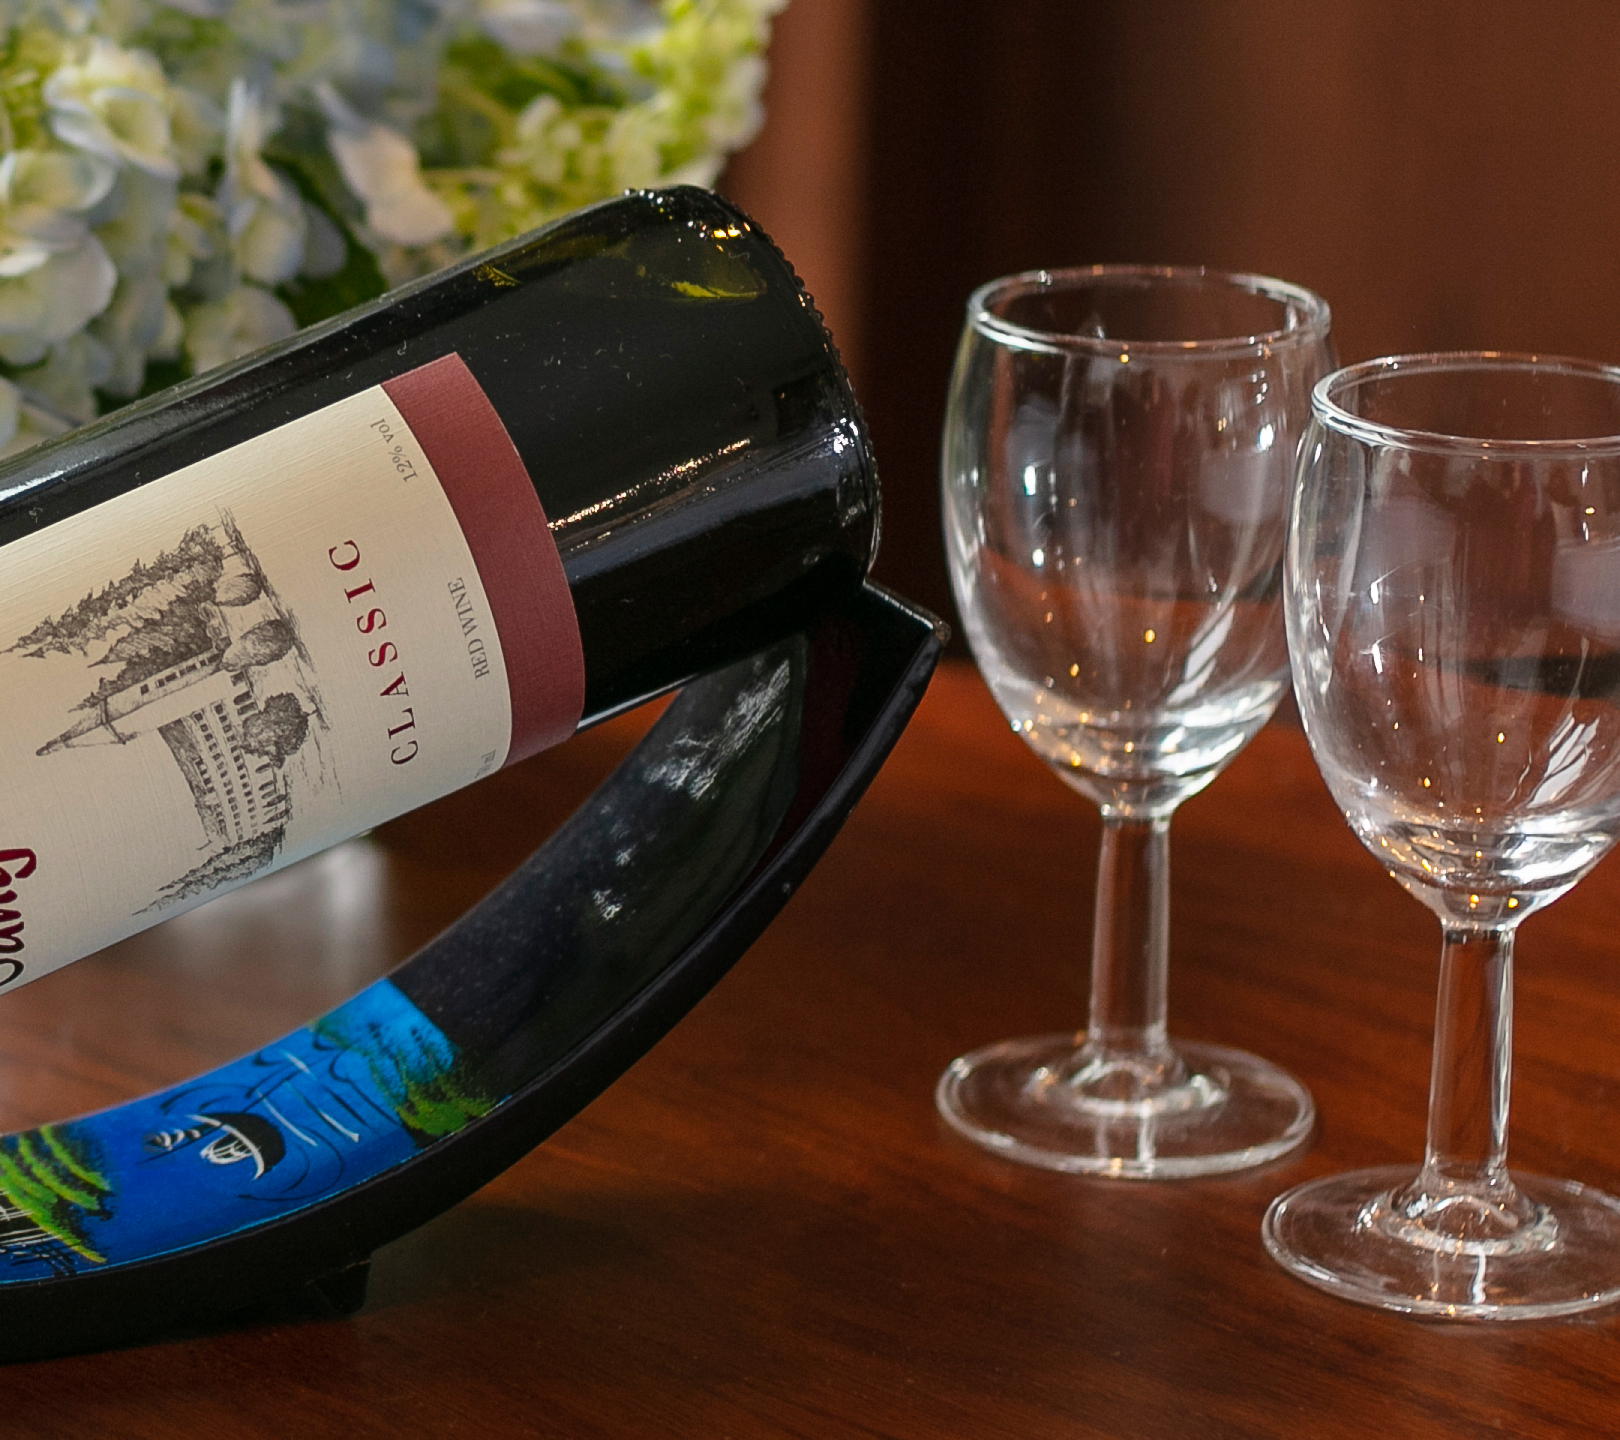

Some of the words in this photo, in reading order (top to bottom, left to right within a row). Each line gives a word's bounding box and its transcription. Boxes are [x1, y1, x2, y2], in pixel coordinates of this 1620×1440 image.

[370, 418, 394, 444] vol
[388, 445, 418, 483] 12%
[447, 577, 478, 637] WINE
[328, 539, 419, 766] CLASSIC
[468, 638, 490, 679] RED
